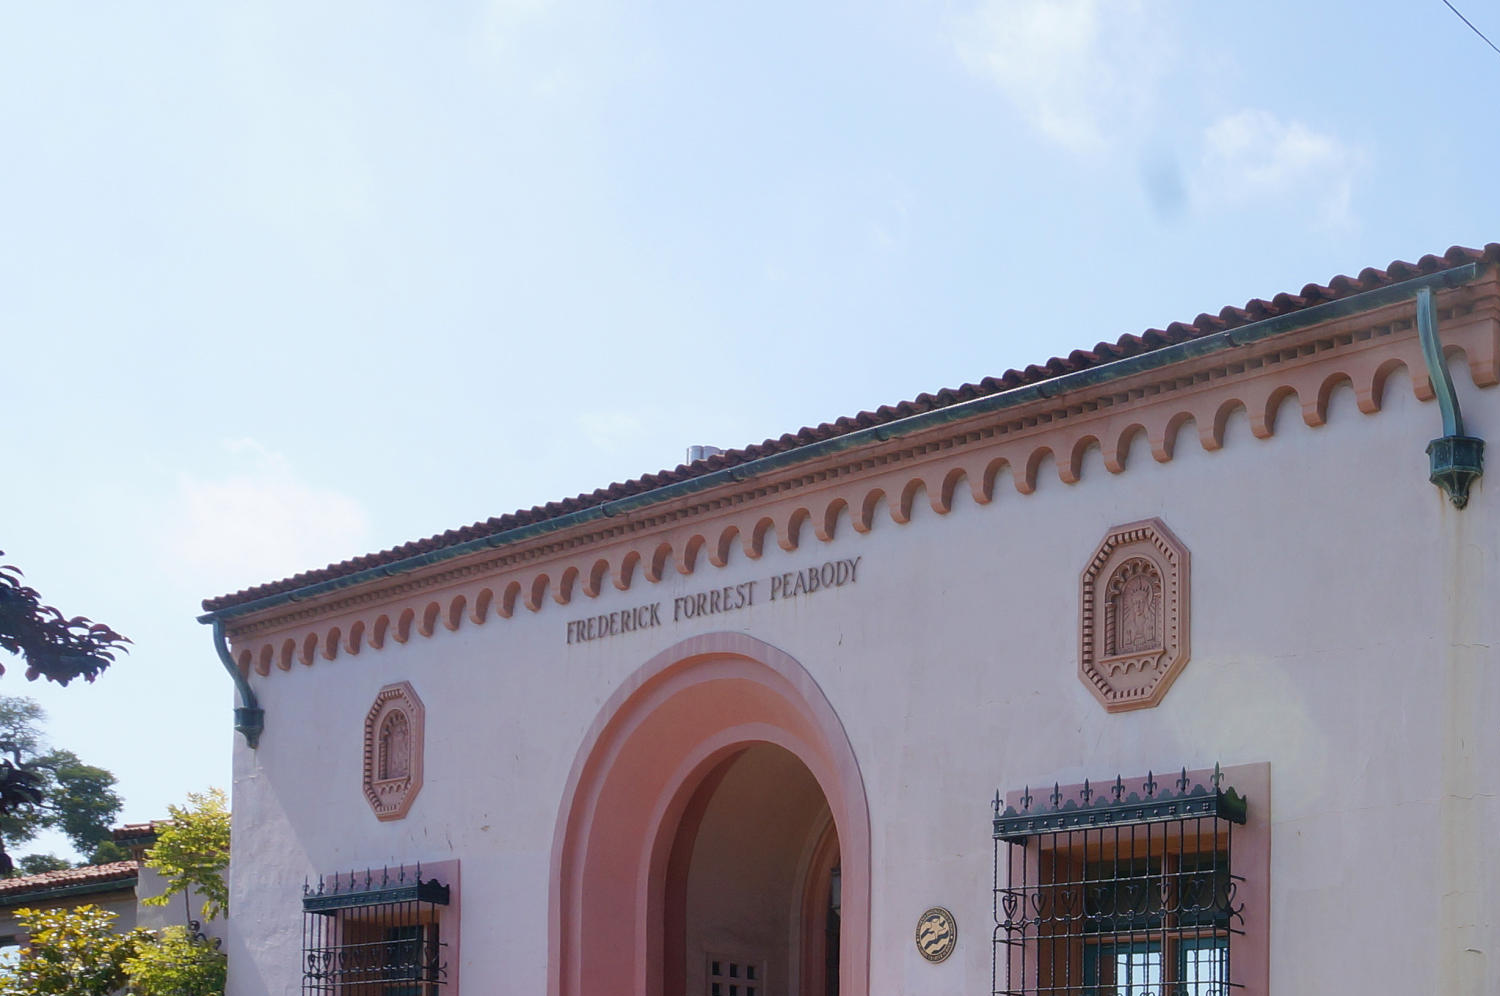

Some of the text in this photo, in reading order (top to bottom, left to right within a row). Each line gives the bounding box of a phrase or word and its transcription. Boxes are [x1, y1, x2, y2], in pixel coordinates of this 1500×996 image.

[566, 556, 862, 645] FREDERICK FORREST PEABODY
